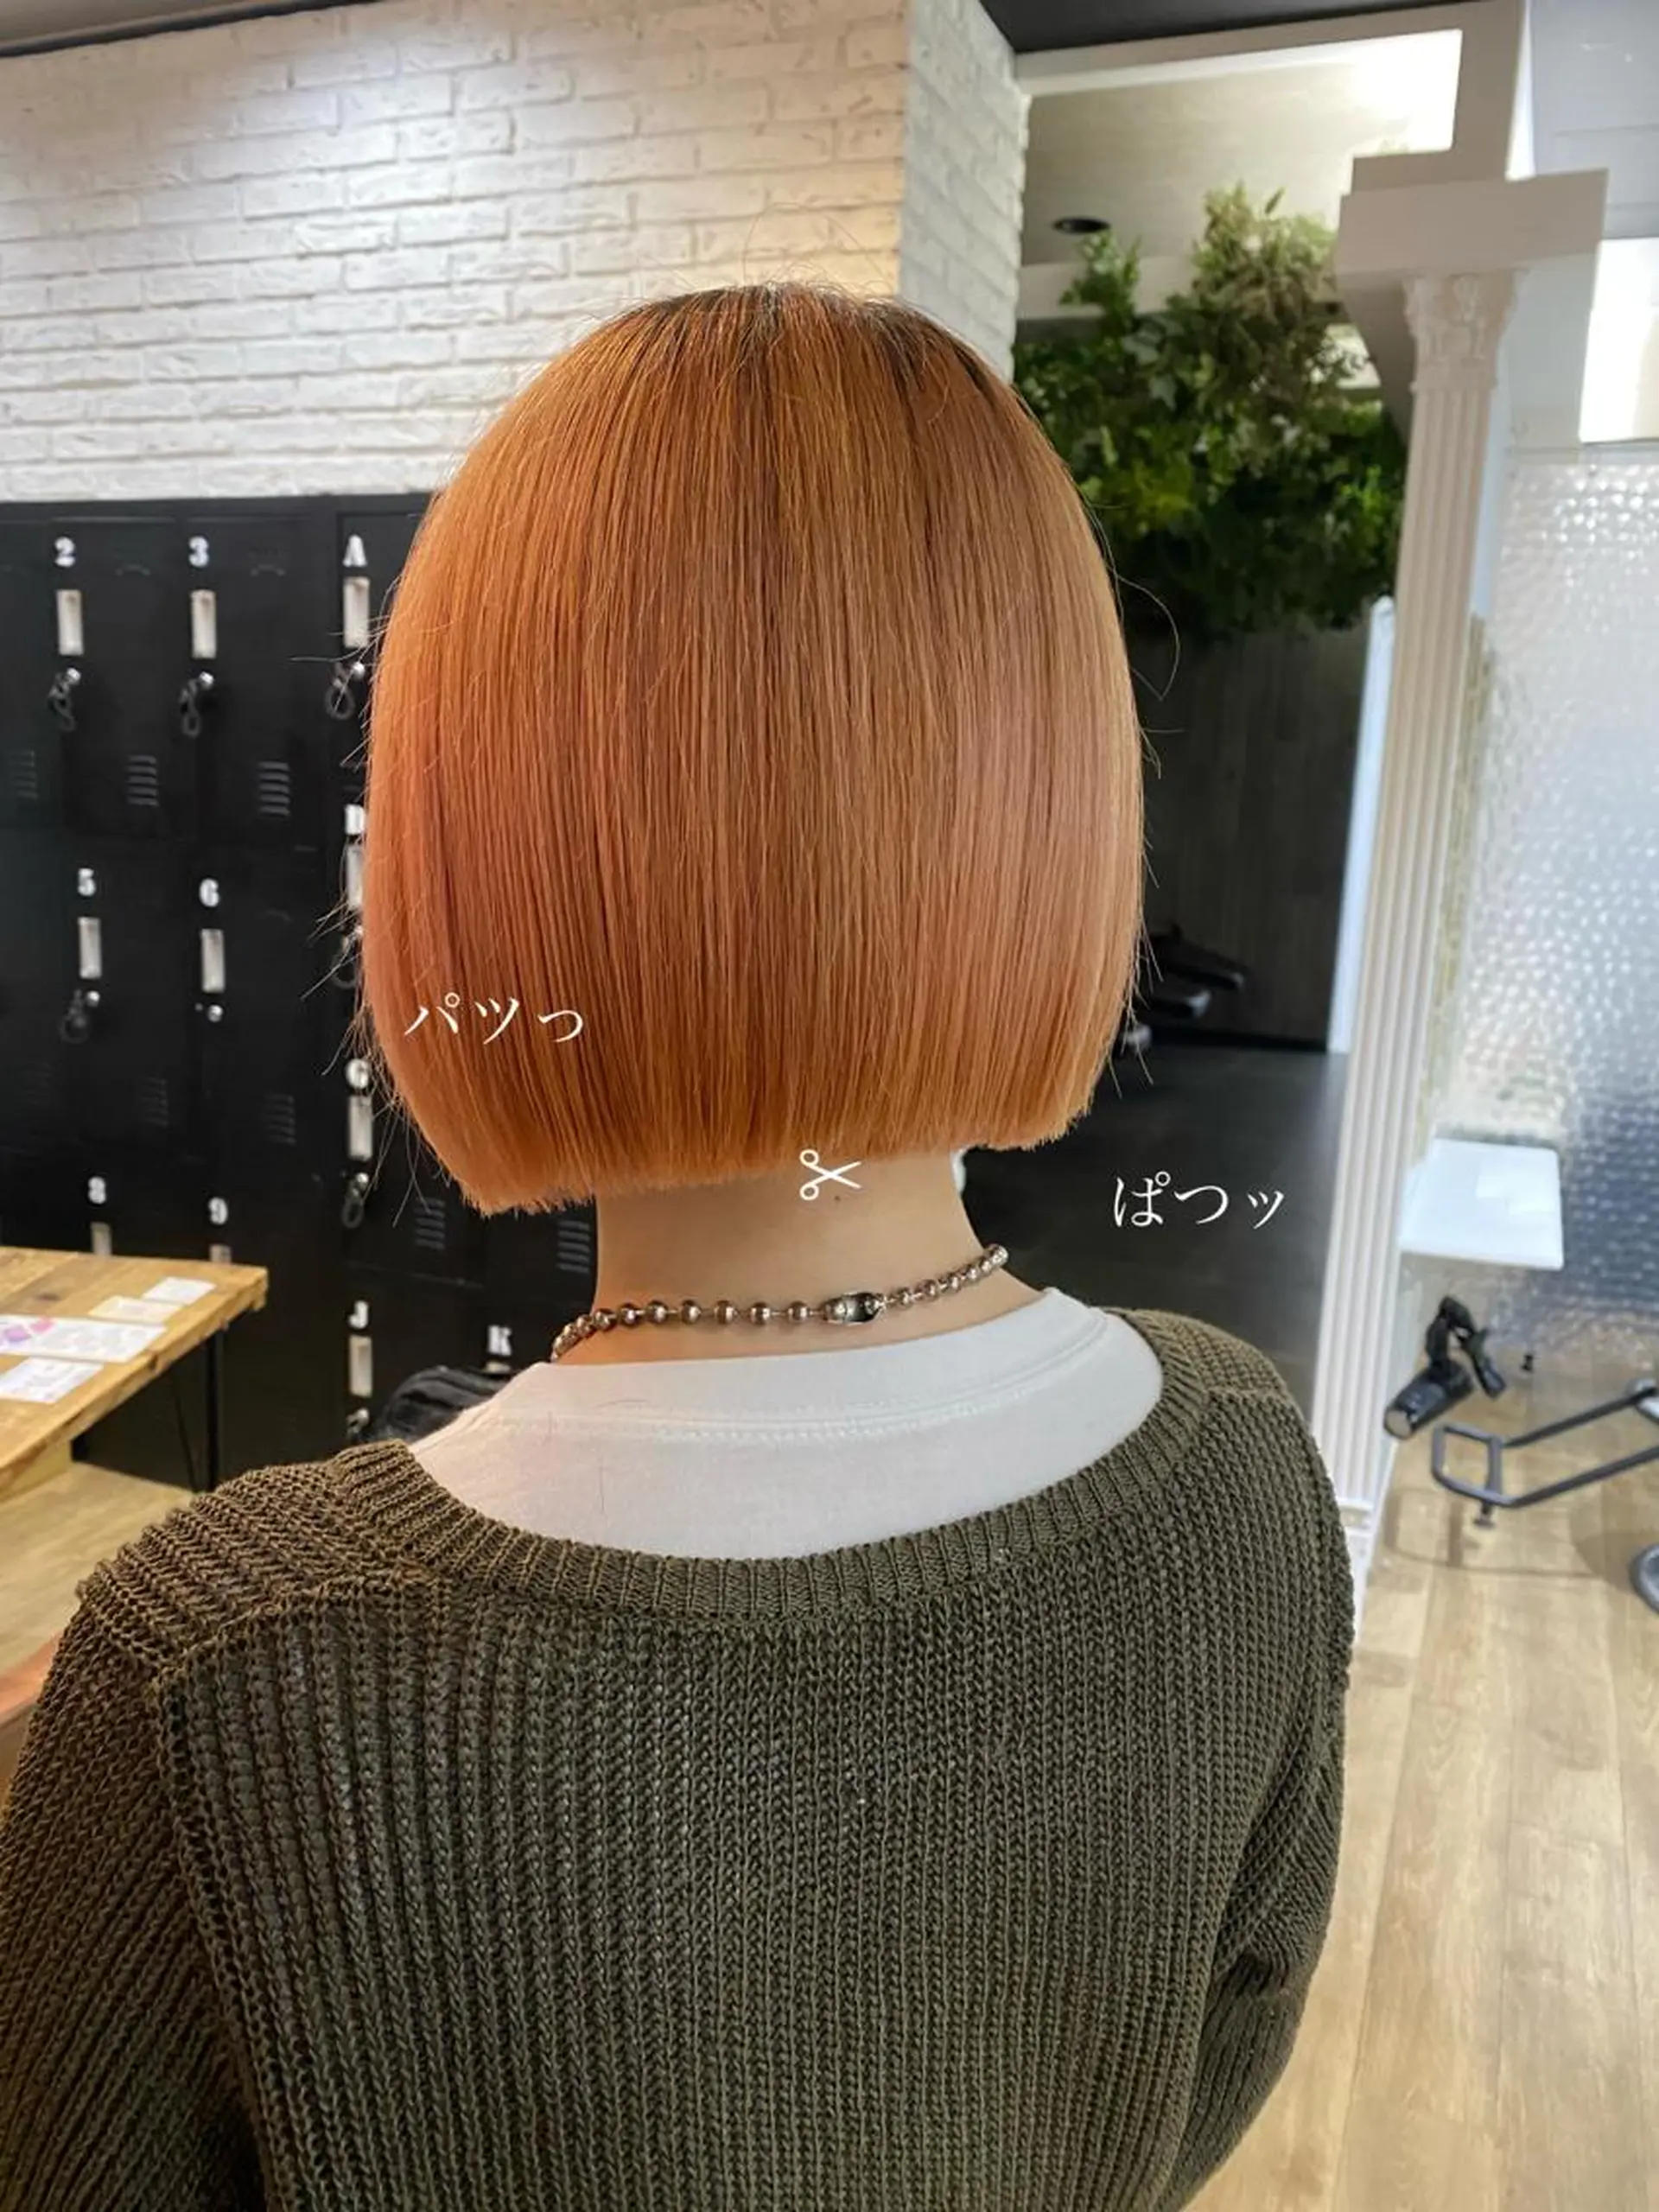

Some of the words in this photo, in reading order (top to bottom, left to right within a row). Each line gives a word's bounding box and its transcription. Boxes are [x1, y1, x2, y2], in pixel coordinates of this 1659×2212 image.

[54, 537, 76, 567] 2
[189, 537, 209, 567] 3
[343, 534, 367, 567] A
[78, 868, 96, 896] 5
[88, 1177, 106, 1205] 8
[208, 1198, 228, 1225] 9
[349, 1300, 368, 1329] J
[488, 1325, 512, 1356] K
